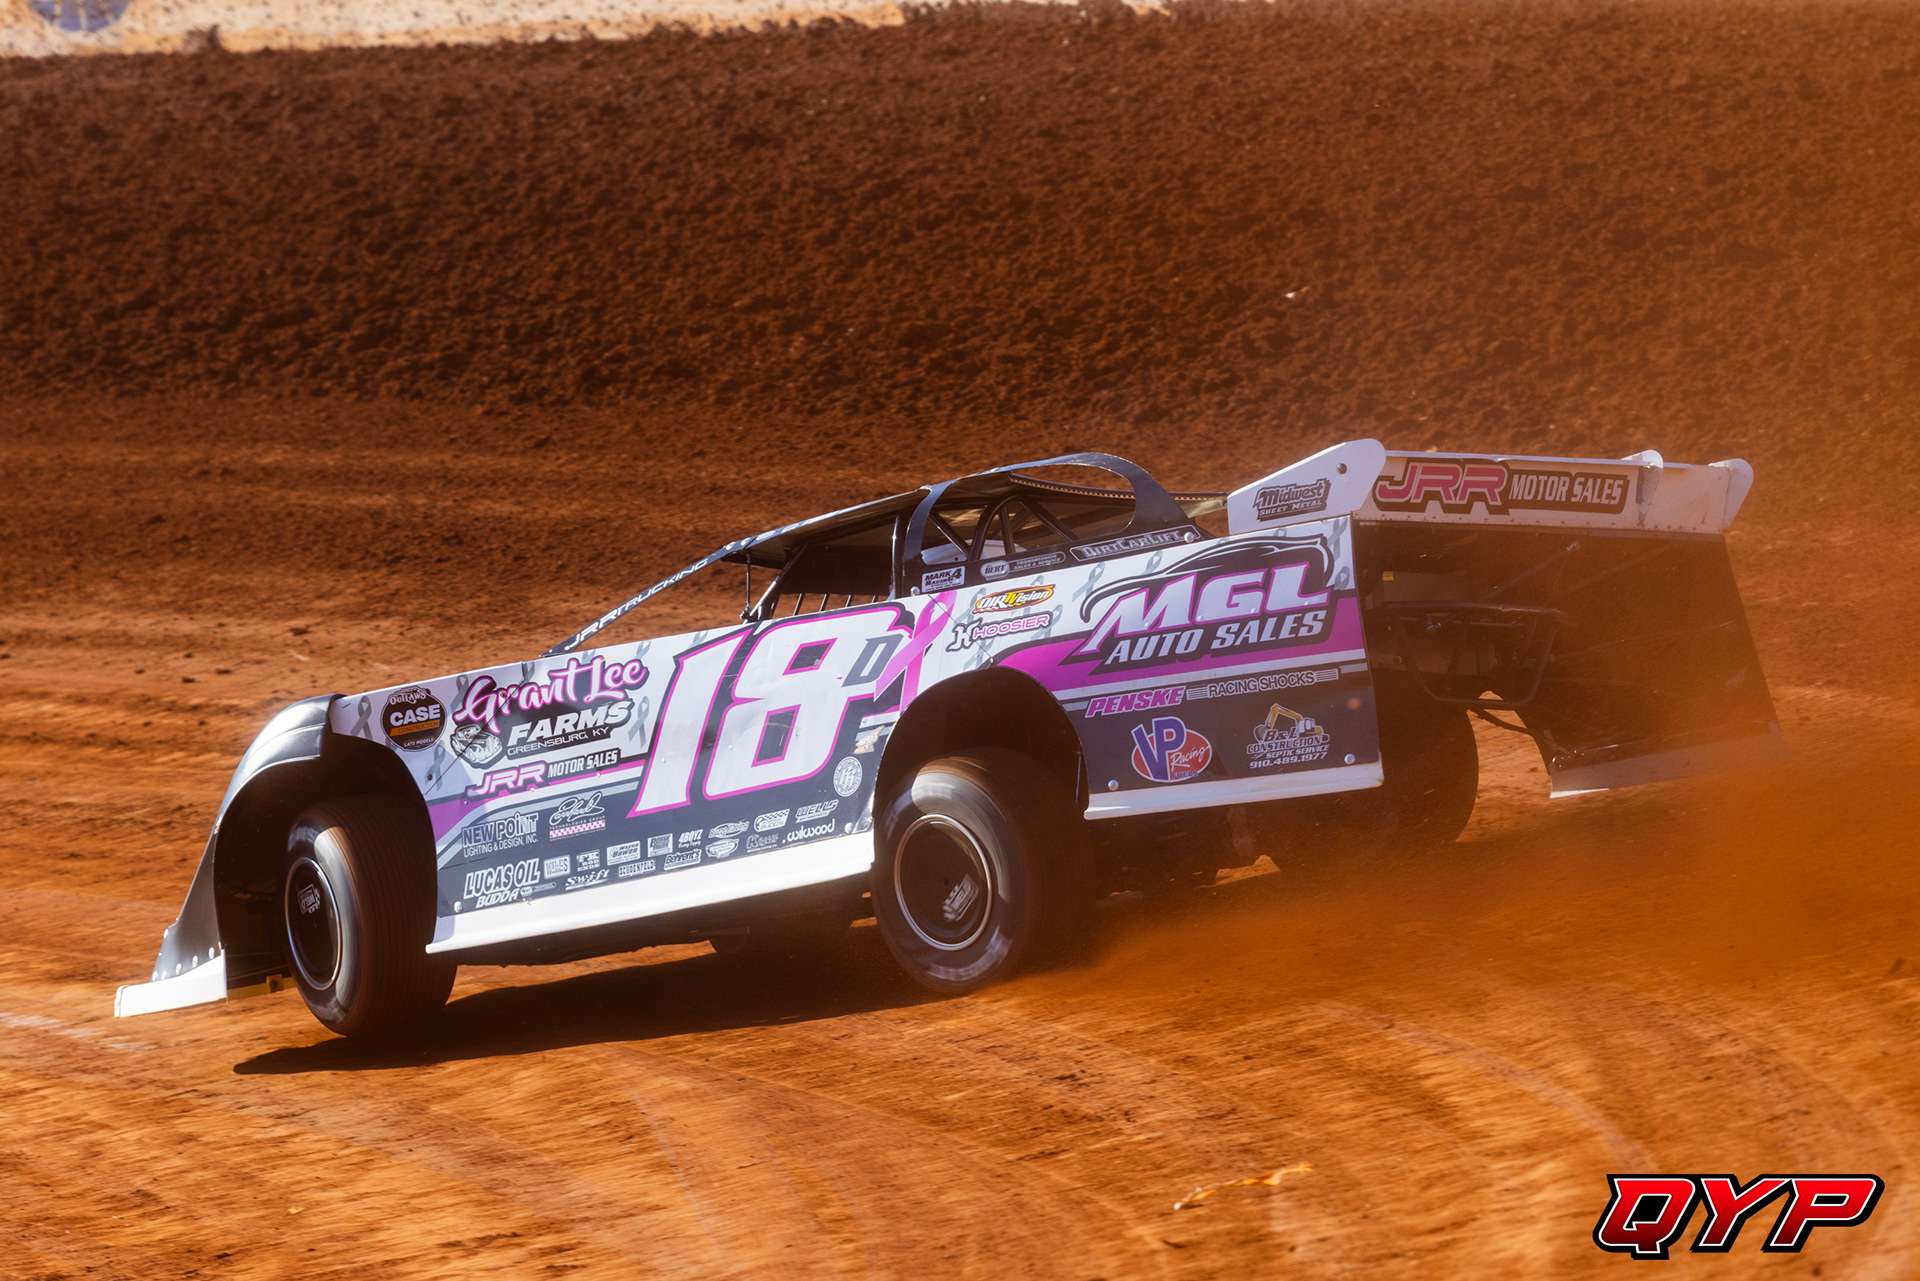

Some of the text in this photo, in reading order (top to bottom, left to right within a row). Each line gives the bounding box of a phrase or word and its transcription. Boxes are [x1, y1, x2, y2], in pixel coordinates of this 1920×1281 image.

[1258, 480, 1326, 509] Midwest
[1375, 461, 1624, 505] JRR MOTOR SALES
[1259, 500, 1322, 516] SHEET METAL
[924, 568, 963, 581] MARK 4
[984, 564, 1006, 575] BERT
[564, 558, 708, 651] JRR TRUCKING
[1079, 561, 1332, 653] MGL
[973, 615, 1050, 640] HOOSIER
[1104, 610, 1327, 665] AUTO SALES
[454, 656, 650, 734] Grant Lee
[1085, 670, 1316, 718] PENSKE RACING SHOCKS
[390, 704, 441, 727] CASE
[625, 606, 902, 818] 18
[398, 721, 439, 734] CONSTRUCTION
[507, 701, 631, 747] FARMS
[592, 726, 610, 738] KY
[1131, 716, 1187, 782] VP
[1247, 734, 1323, 755] CONSTRUCTION
[1266, 744, 1330, 759] SEPTIC SERVICE
[1169, 745, 1210, 768] Racing
[1249, 752, 1327, 769] 910.489.1977
[466, 750, 618, 798] JRR MOTOR SALES
[1171, 769, 1199, 779] FUELS
[796, 799, 839, 818] WELLS
[461, 821, 495, 848] NEW
[786, 819, 835, 842] wilwood
[463, 844, 493, 858] LIGHTING
[499, 837, 525, 851] DESIGN,
[525, 834, 539, 844] INC.
[577, 863, 600, 872] ENDS
[582, 859, 599, 867] ROD
[463, 863, 514, 900] LUCAS
[513, 857, 540, 888] OIL
[565, 869, 611, 887] Swift
[476, 888, 521, 909] BUDDA
